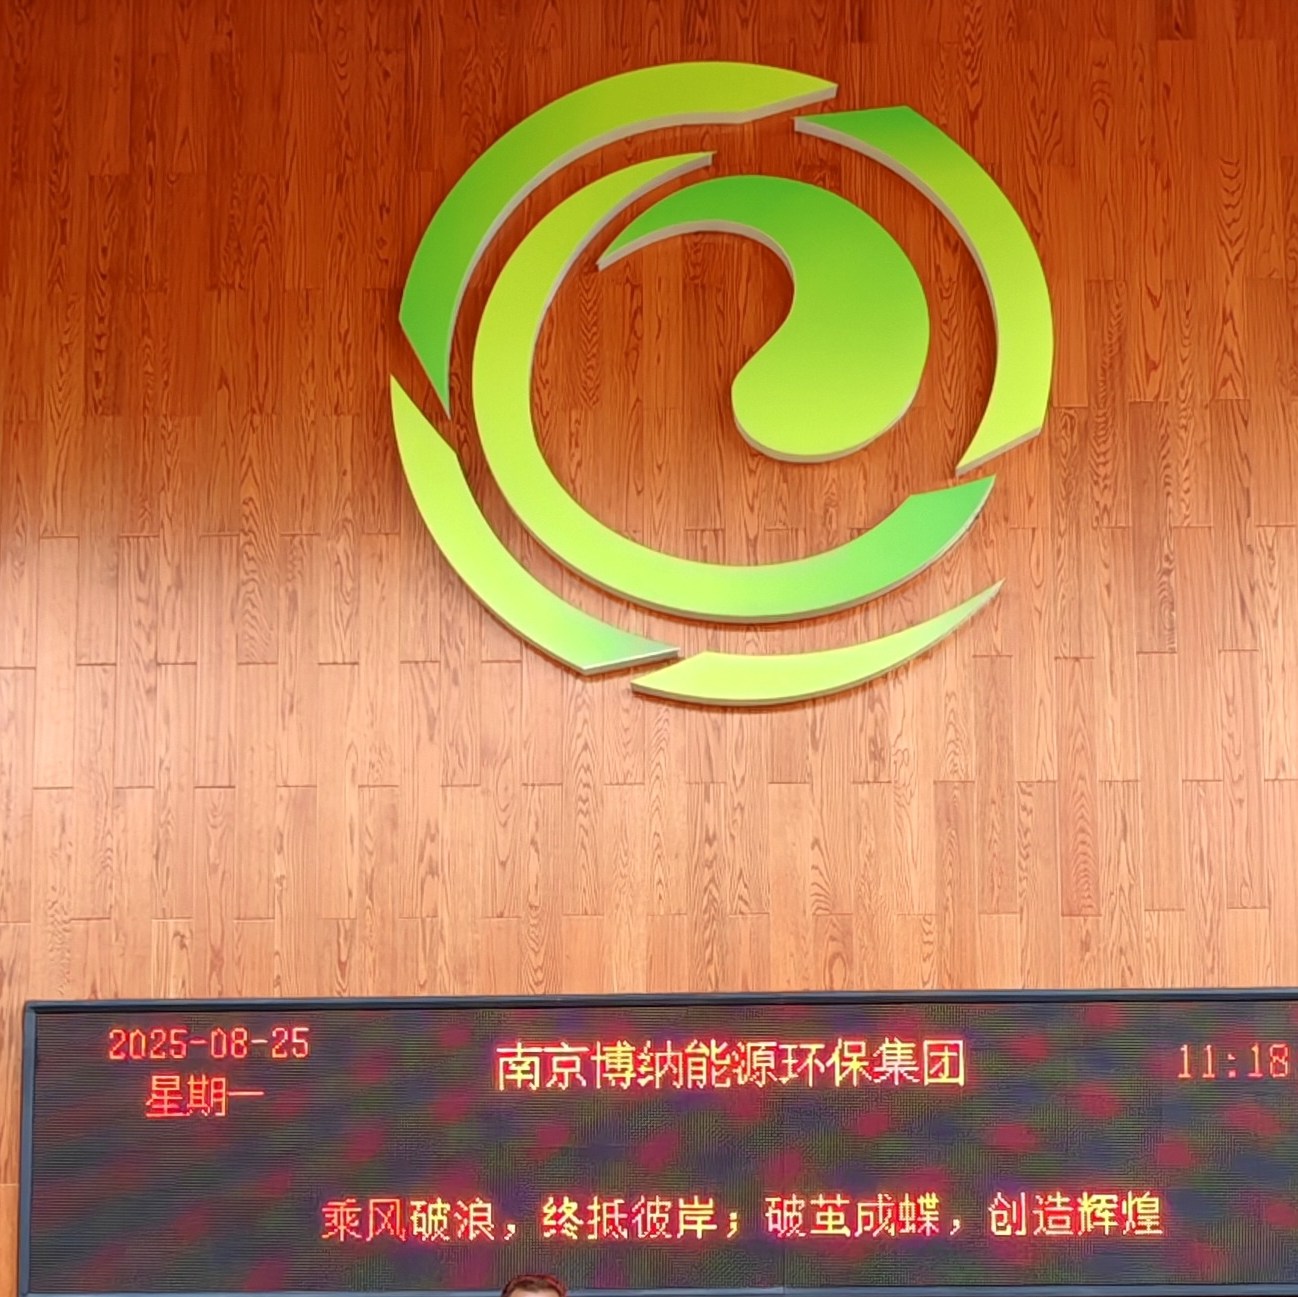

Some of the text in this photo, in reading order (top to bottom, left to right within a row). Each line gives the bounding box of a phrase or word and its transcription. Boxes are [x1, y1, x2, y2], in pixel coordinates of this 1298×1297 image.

[108, 1027, 310, 1060] 2025-08-25
[496, 1038, 965, 1091] 南京博纳能源环保集团
[145, 1074, 265, 1118] 星期一
